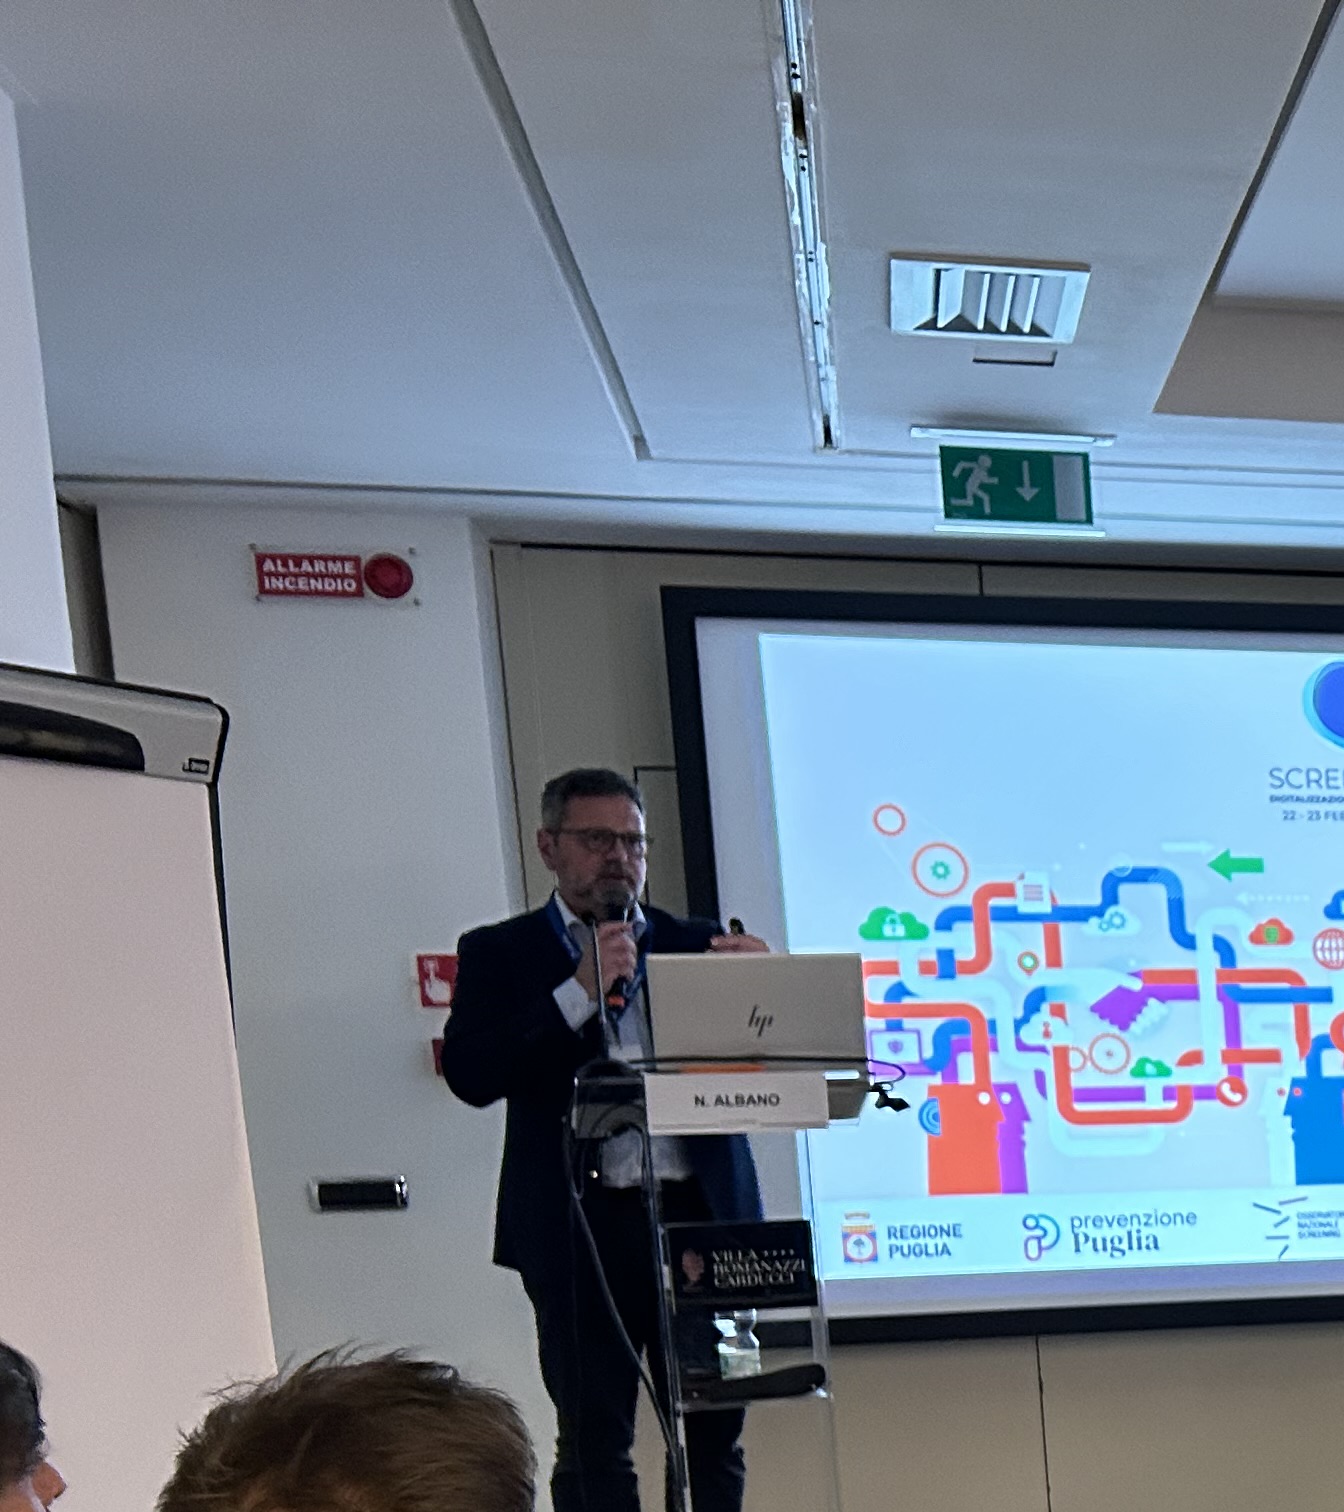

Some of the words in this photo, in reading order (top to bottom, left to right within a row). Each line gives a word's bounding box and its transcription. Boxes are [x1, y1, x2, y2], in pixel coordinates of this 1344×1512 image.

[263, 558, 356, 574] ALLARME
[264, 576, 356, 591] INCENDIO
[1282, 810, 1296, 821] 22
[1307, 810, 1321, 821] 23
[694, 1093, 710, 1107] N.
[714, 1093, 780, 1108] ALBANO
[1071, 1208, 1198, 1230] prevenzione
[887, 1223, 963, 1239] REGIONE
[888, 1242, 952, 1259] PUGLIA
[1073, 1230, 1160, 1258] Puglia
